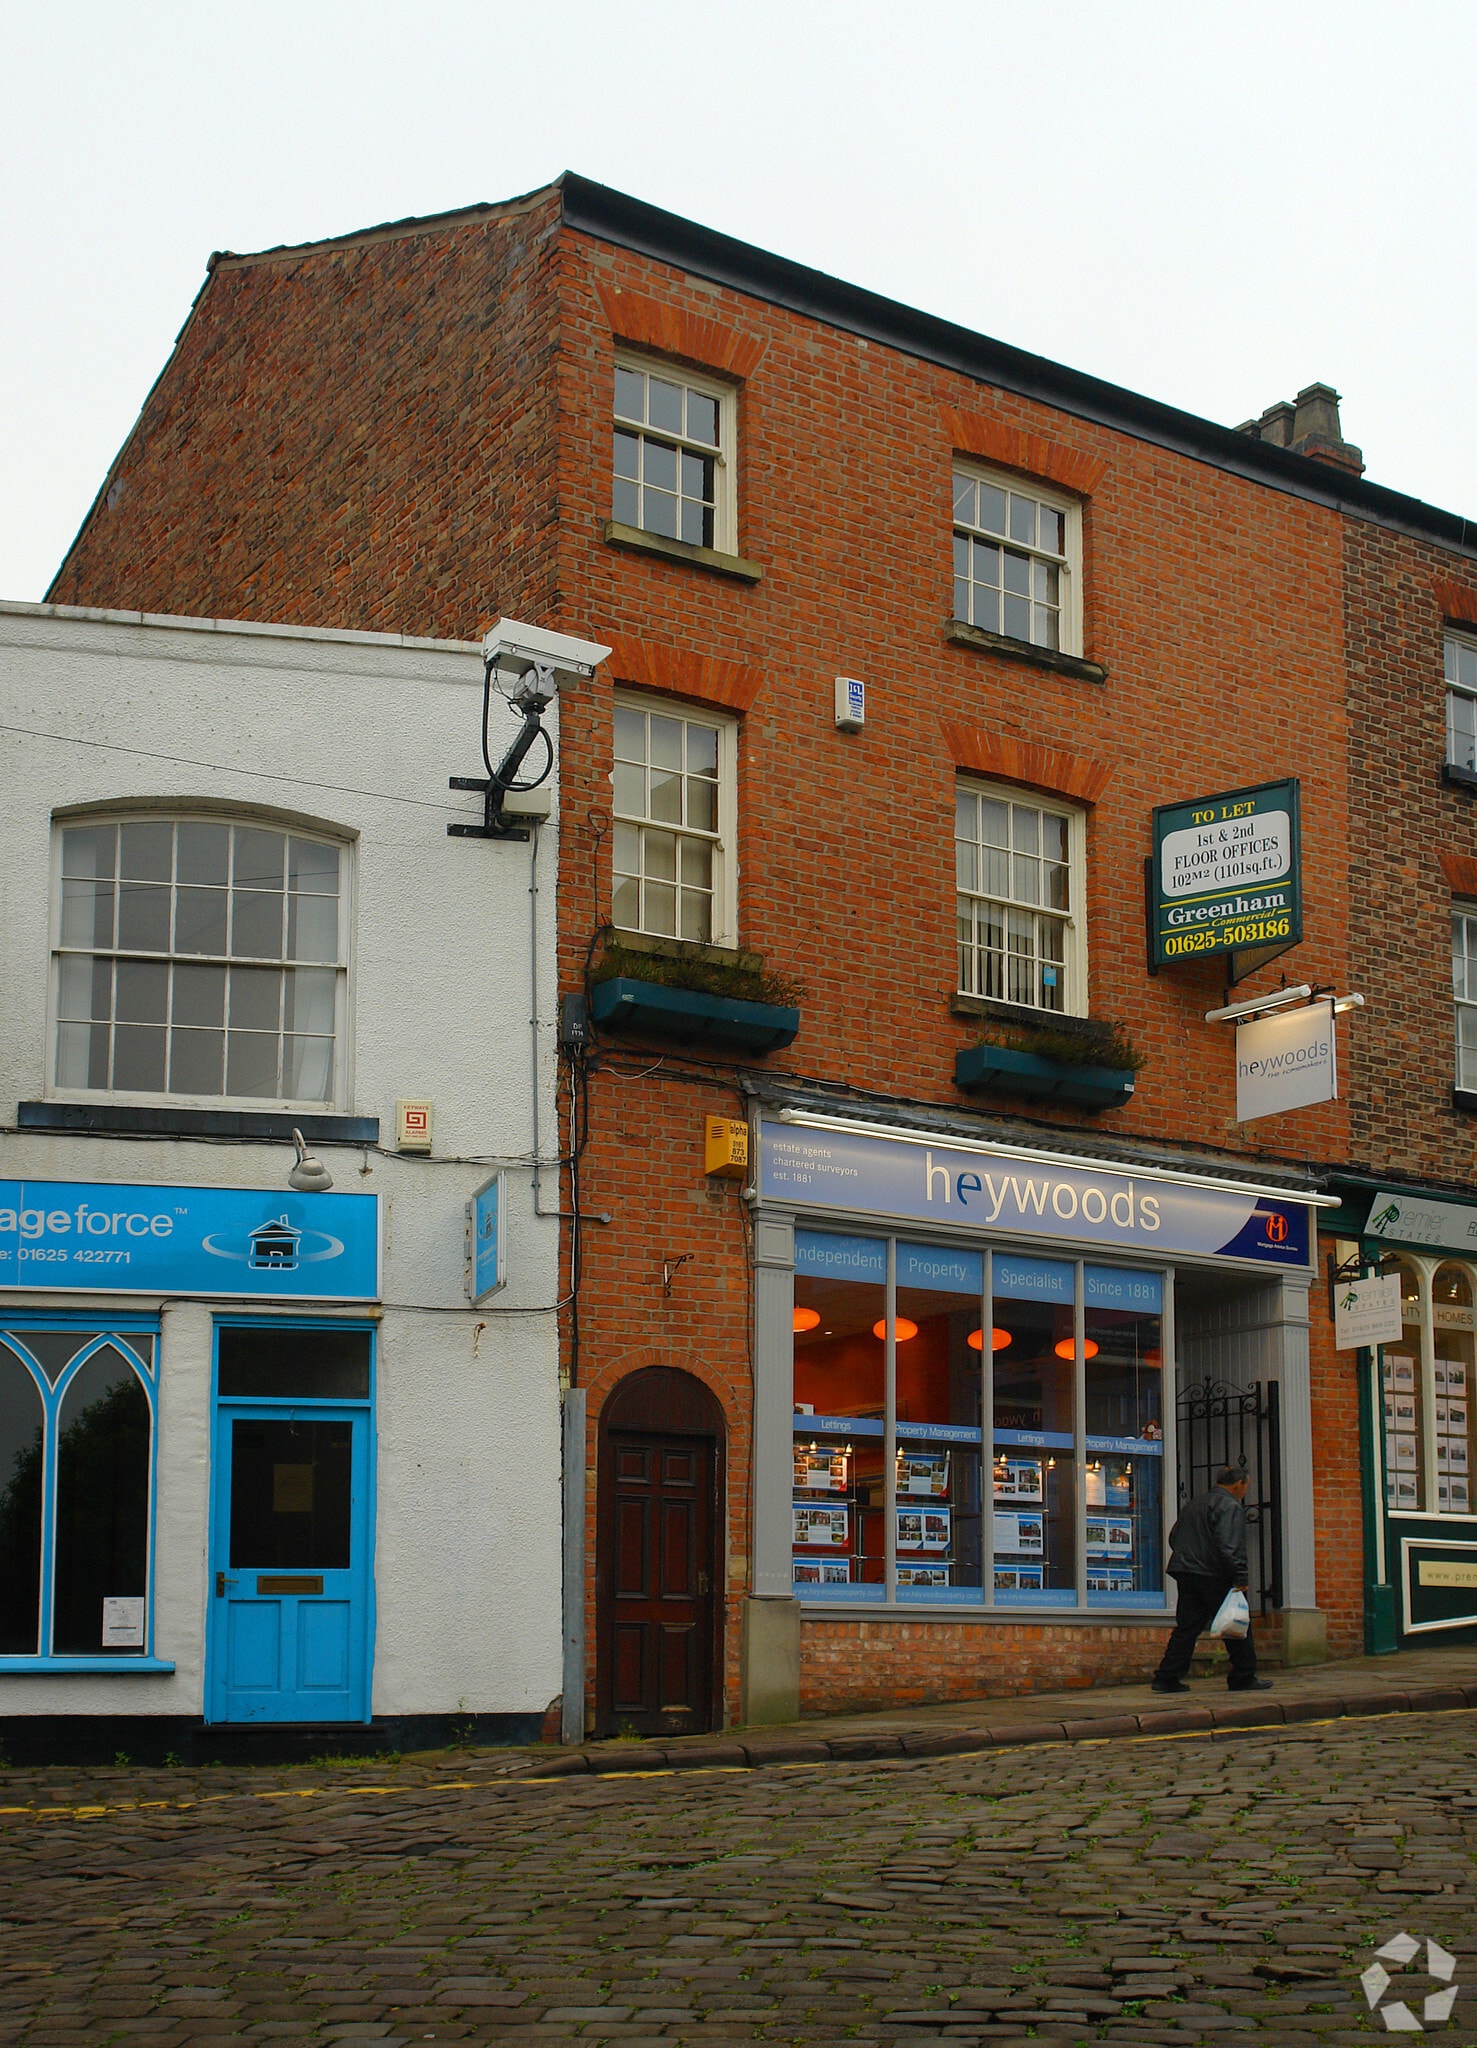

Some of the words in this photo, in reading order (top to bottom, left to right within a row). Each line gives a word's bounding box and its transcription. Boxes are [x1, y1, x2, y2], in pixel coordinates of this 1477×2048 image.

[1192, 809, 1215, 825] TO
[1221, 801, 1256, 819] LET
[1197, 833, 1214, 847] 1st
[1218, 828, 1228, 843] &
[1232, 823, 1254, 840] 2nd
[1174, 849, 1218, 871] FLOOR
[1222, 836, 1279, 860] OFFICES
[1168, 893, 1286, 926] Greenham
[1211, 908, 1277, 927] Commercial
[1165, 917, 1290, 956] 01625-503186
[1239, 1040, 1329, 1078] heywoods
[729, 1122, 747, 1138] alpha
[730, 1154, 746, 1164] 7087
[731, 1147, 745, 1156] 873
[772, 1142, 800, 1155] estate
[802, 1146, 832, 1159] agents
[772, 1156, 815, 1171] chartered
[817, 1162, 859, 1177] surveyors
[772, 1171, 790, 1181] est.
[793, 1172, 813, 1184] 1881
[926, 1150, 1162, 1231] heywoods
[17, 1248, 68, 1261] 01625
[73, 1250, 131, 1264] 422771
[794, 1243, 883, 1270] Independent
[909, 1257, 967, 1282] Property
[1001, 1268, 1064, 1290] Specialist
[1088, 1278, 1122, 1297] Since
[1127, 1282, 1155, 1300] 1881
[1437, 1311, 1474, 1325] HOMES
[821, 1419, 852, 1431] Lettings
[896, 1424, 927, 1438] Property
[929, 1426, 978, 1440] Management
[1017, 1433, 1045, 1444] Lettings
[1086, 1438, 1114, 1450] Property
[1115, 1440, 1158, 1452] Management
